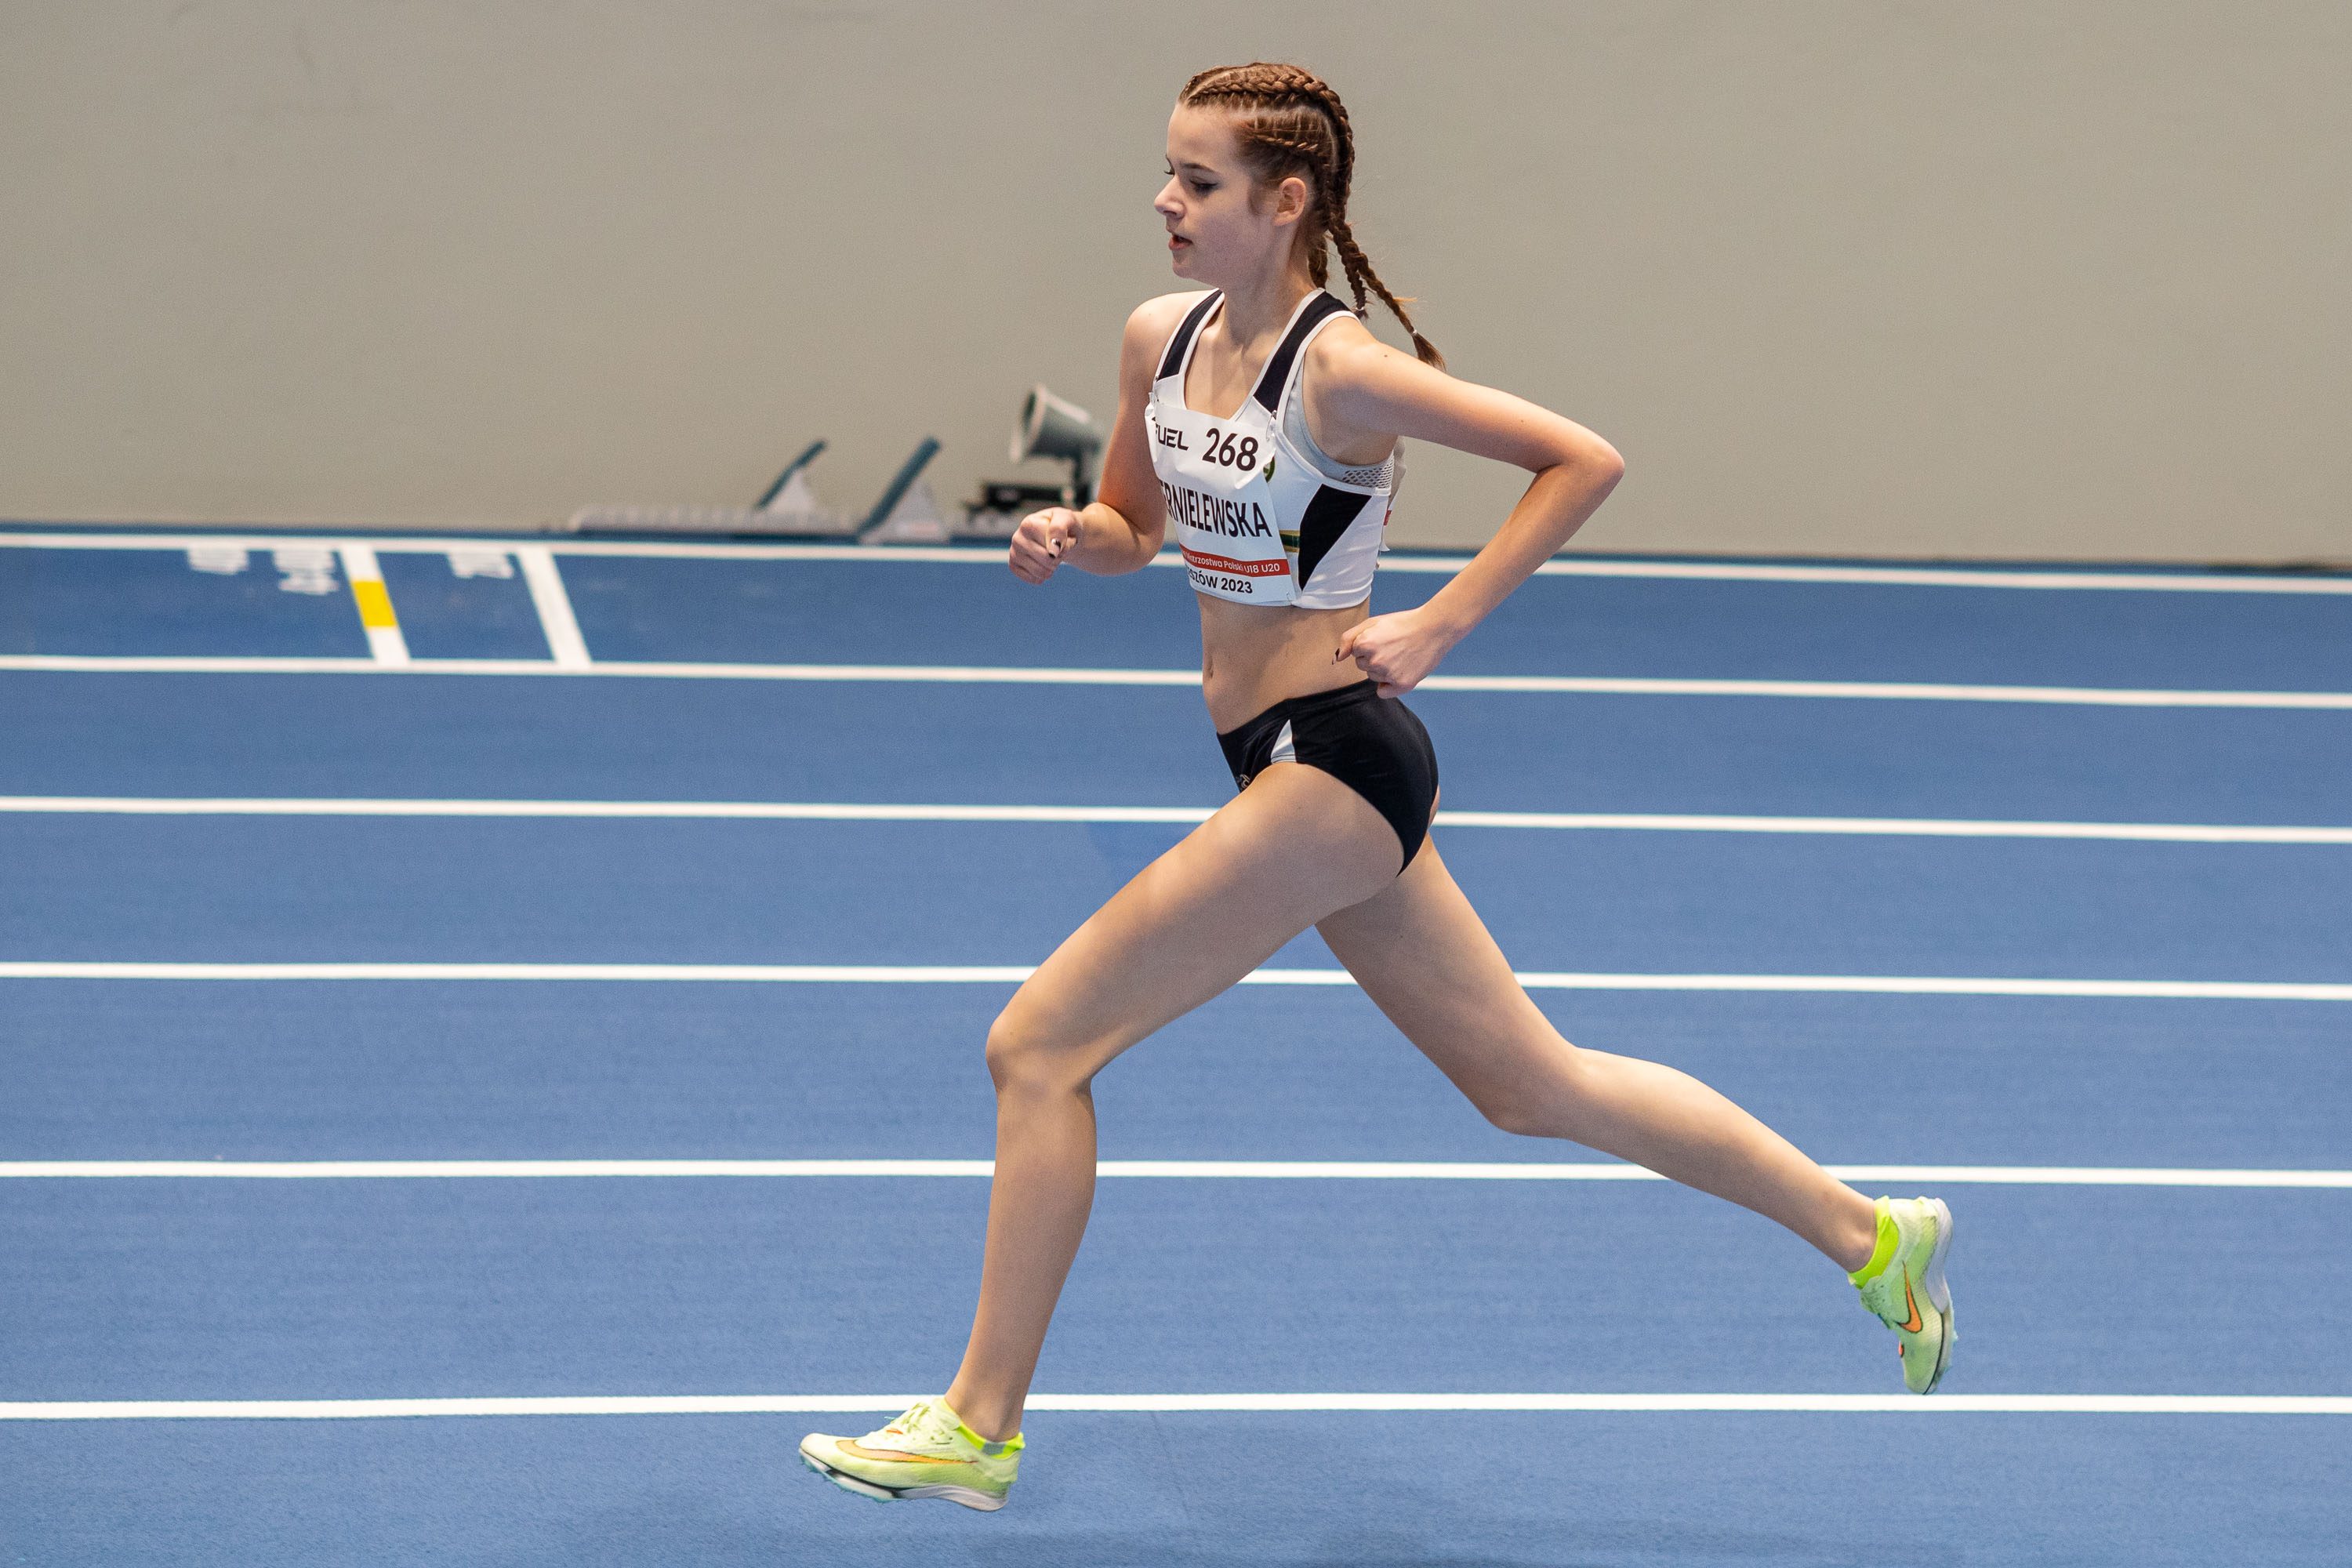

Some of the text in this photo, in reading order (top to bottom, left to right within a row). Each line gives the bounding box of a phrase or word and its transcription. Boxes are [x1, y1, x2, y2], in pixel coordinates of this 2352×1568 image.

[1203, 428, 1258, 471] 268
[1185, 564, 1253, 593] SZÓW 2023
[1224, 561, 1243, 572] Polski
[1244, 564, 1259, 573] U18
[1261, 563, 1280, 572] U20
